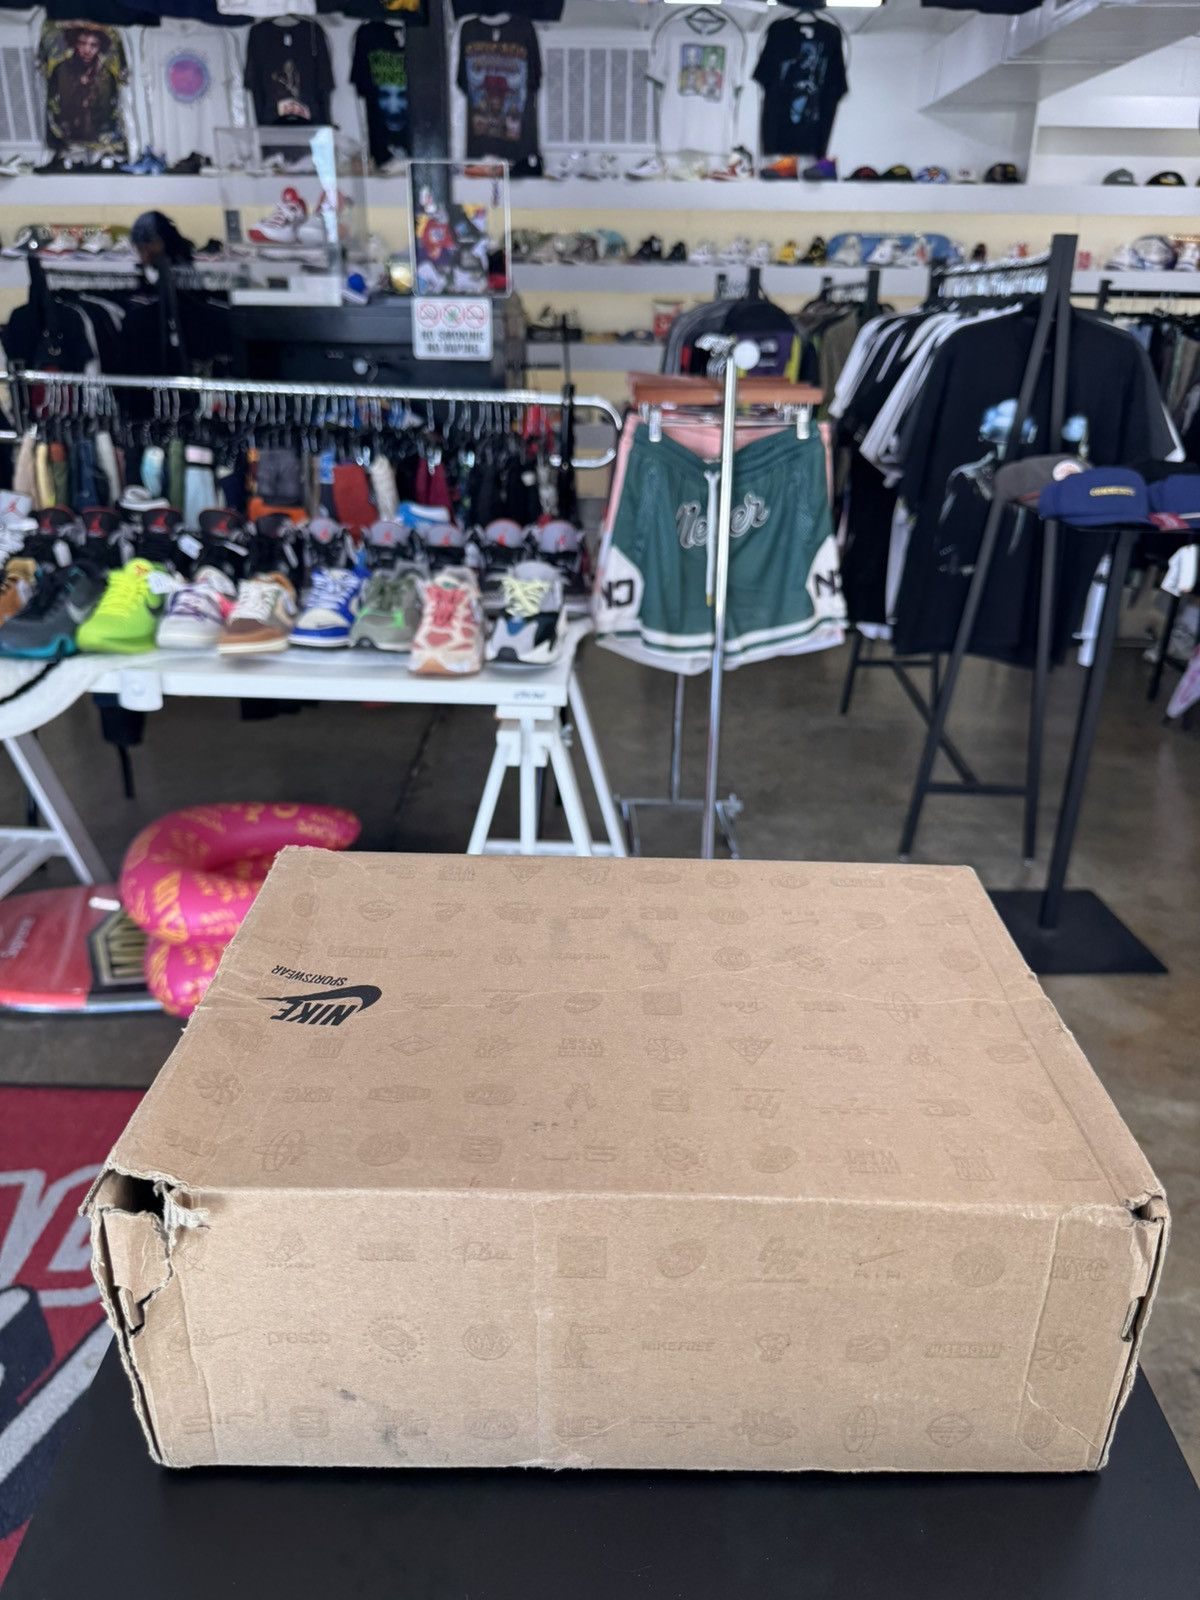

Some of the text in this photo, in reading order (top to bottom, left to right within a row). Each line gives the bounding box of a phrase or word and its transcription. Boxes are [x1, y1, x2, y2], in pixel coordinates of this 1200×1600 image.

[676, 491, 770, 549] Neer
[271, 964, 348, 986] SPORTSWEAR
[270, 999, 358, 1026] NIKE
[266, 1331, 332, 1346] presto
